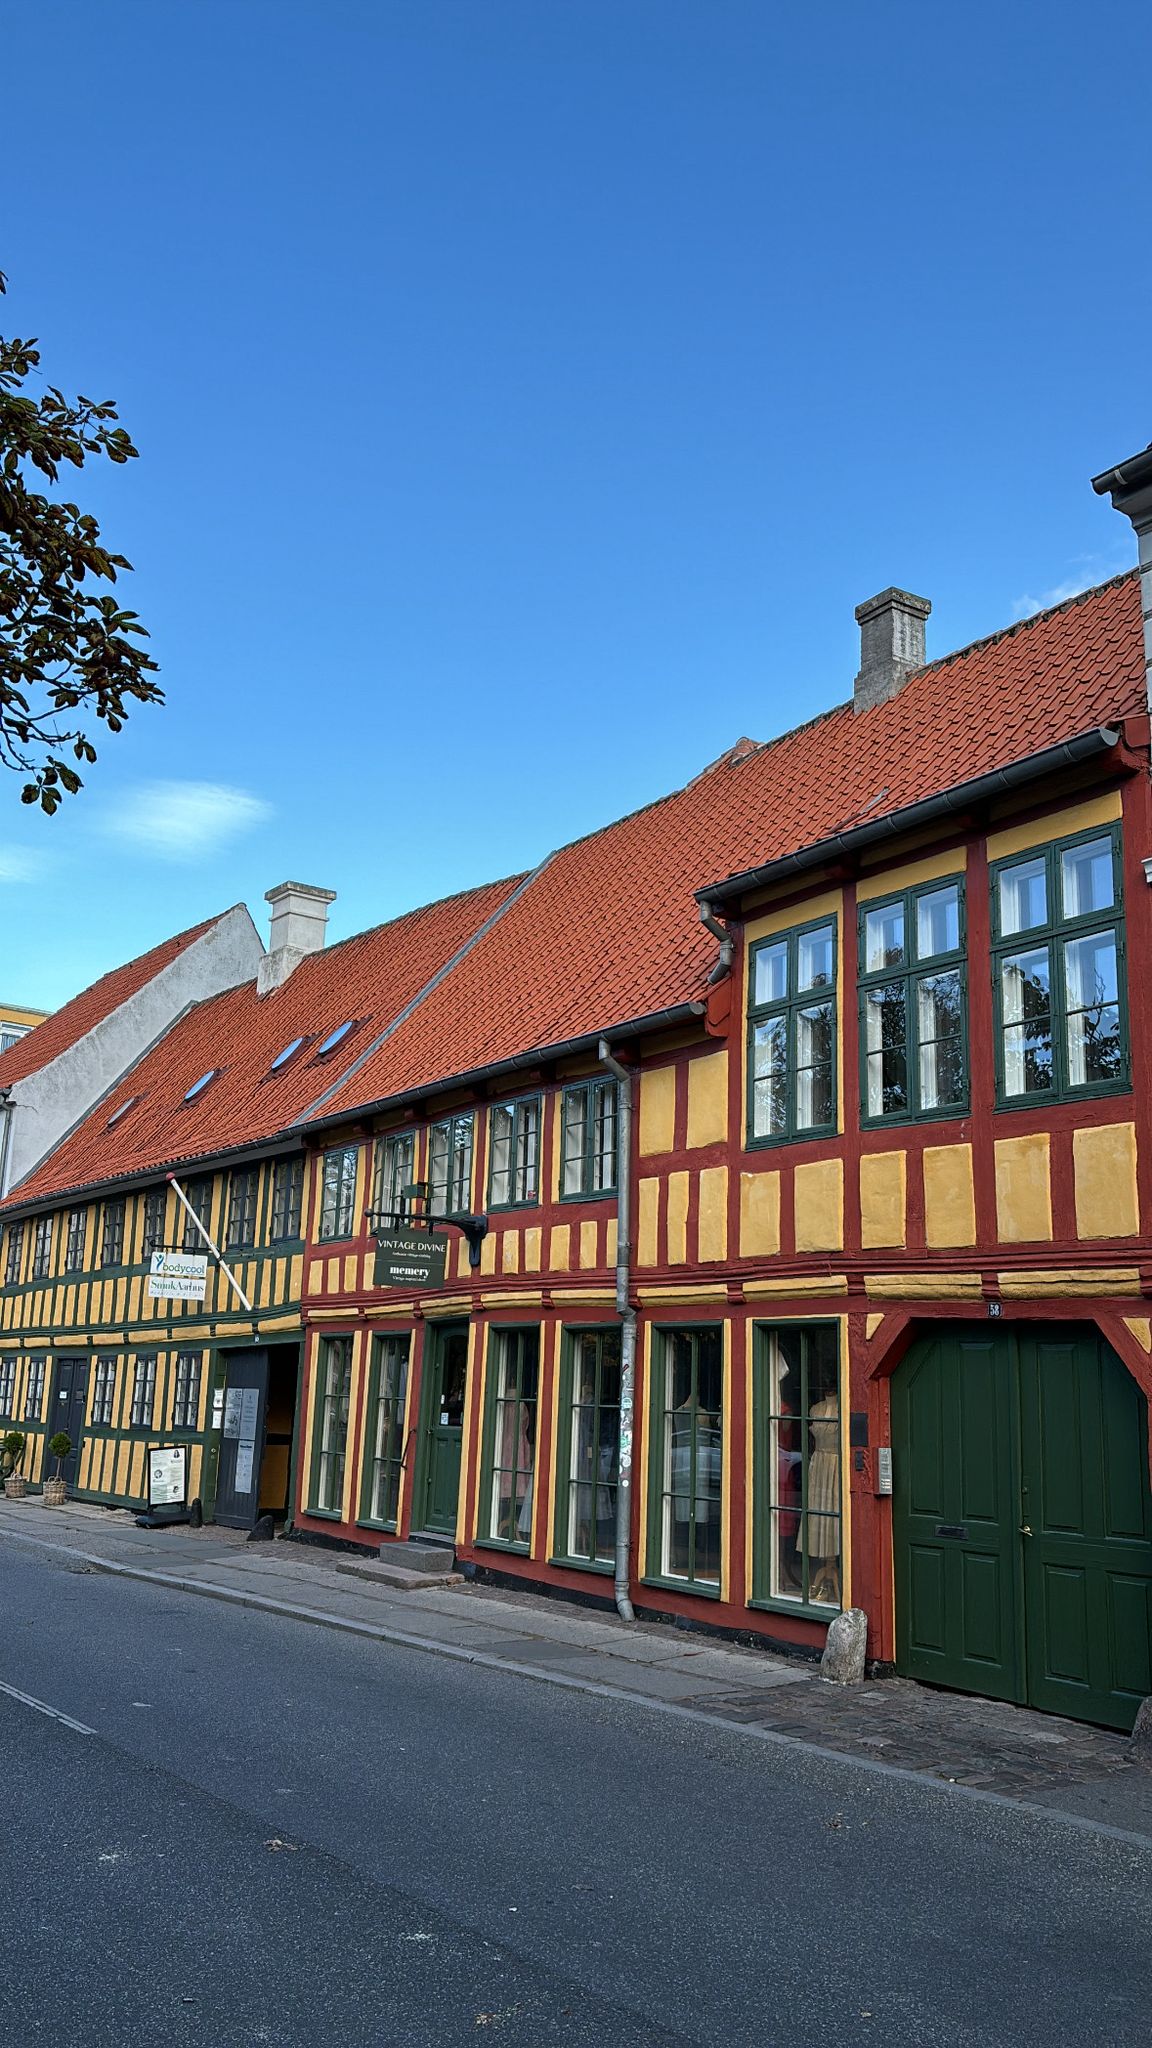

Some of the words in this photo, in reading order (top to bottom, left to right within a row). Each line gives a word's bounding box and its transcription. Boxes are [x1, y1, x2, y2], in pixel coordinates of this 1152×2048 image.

[377, 1239, 417, 1251] VINTAGE
[417, 1242, 446, 1253] DIVINE
[162, 1262, 205, 1275] bodycool
[990, 1304, 1000, 1316] 58
